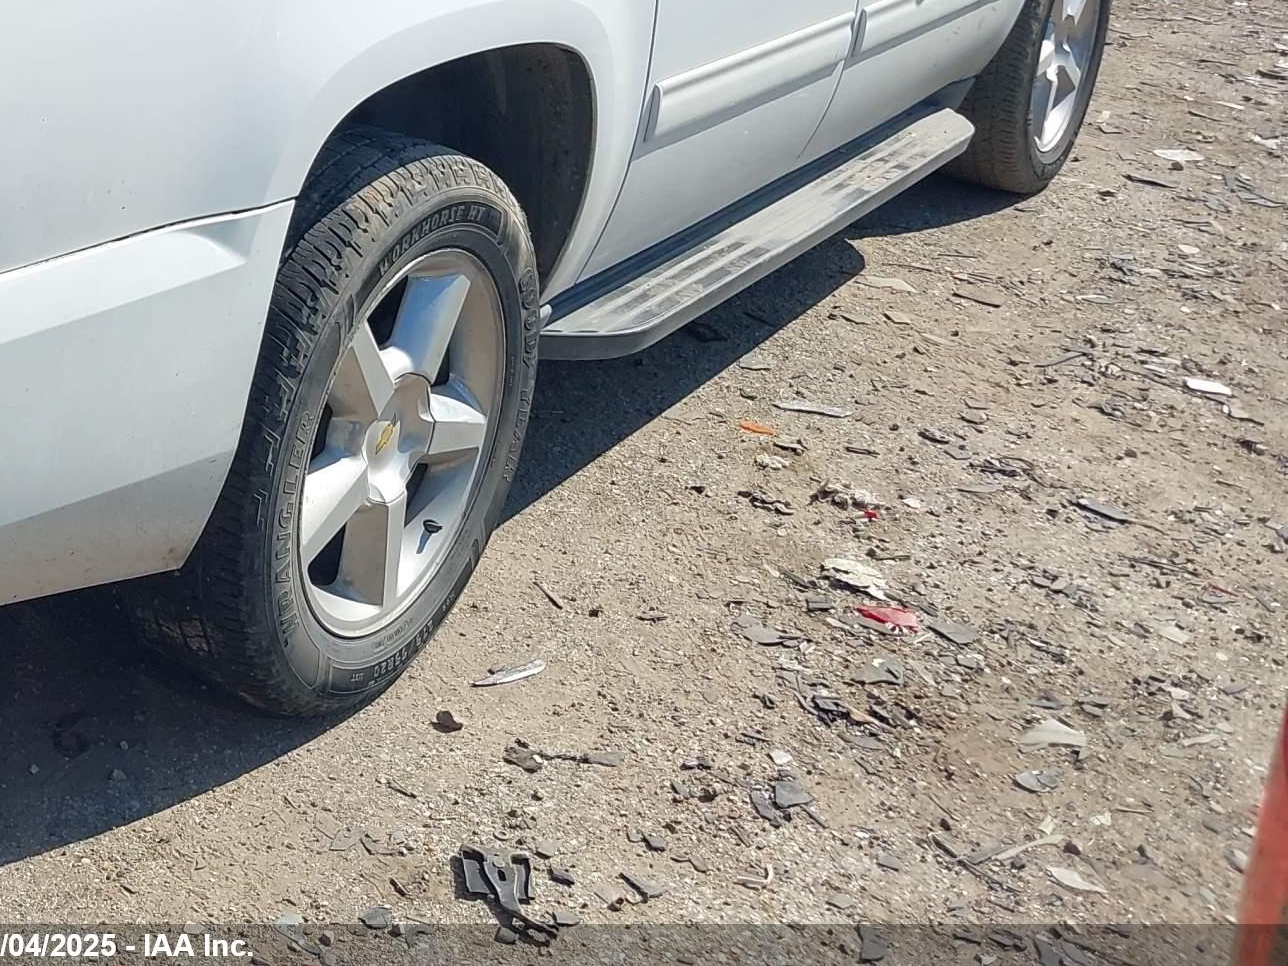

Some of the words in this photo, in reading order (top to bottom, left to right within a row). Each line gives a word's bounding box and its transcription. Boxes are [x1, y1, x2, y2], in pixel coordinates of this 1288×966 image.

[378, 205, 467, 277] WORKHORSE
[467, 205, 488, 224] HT
[274, 410, 315, 648] WRANGLER
